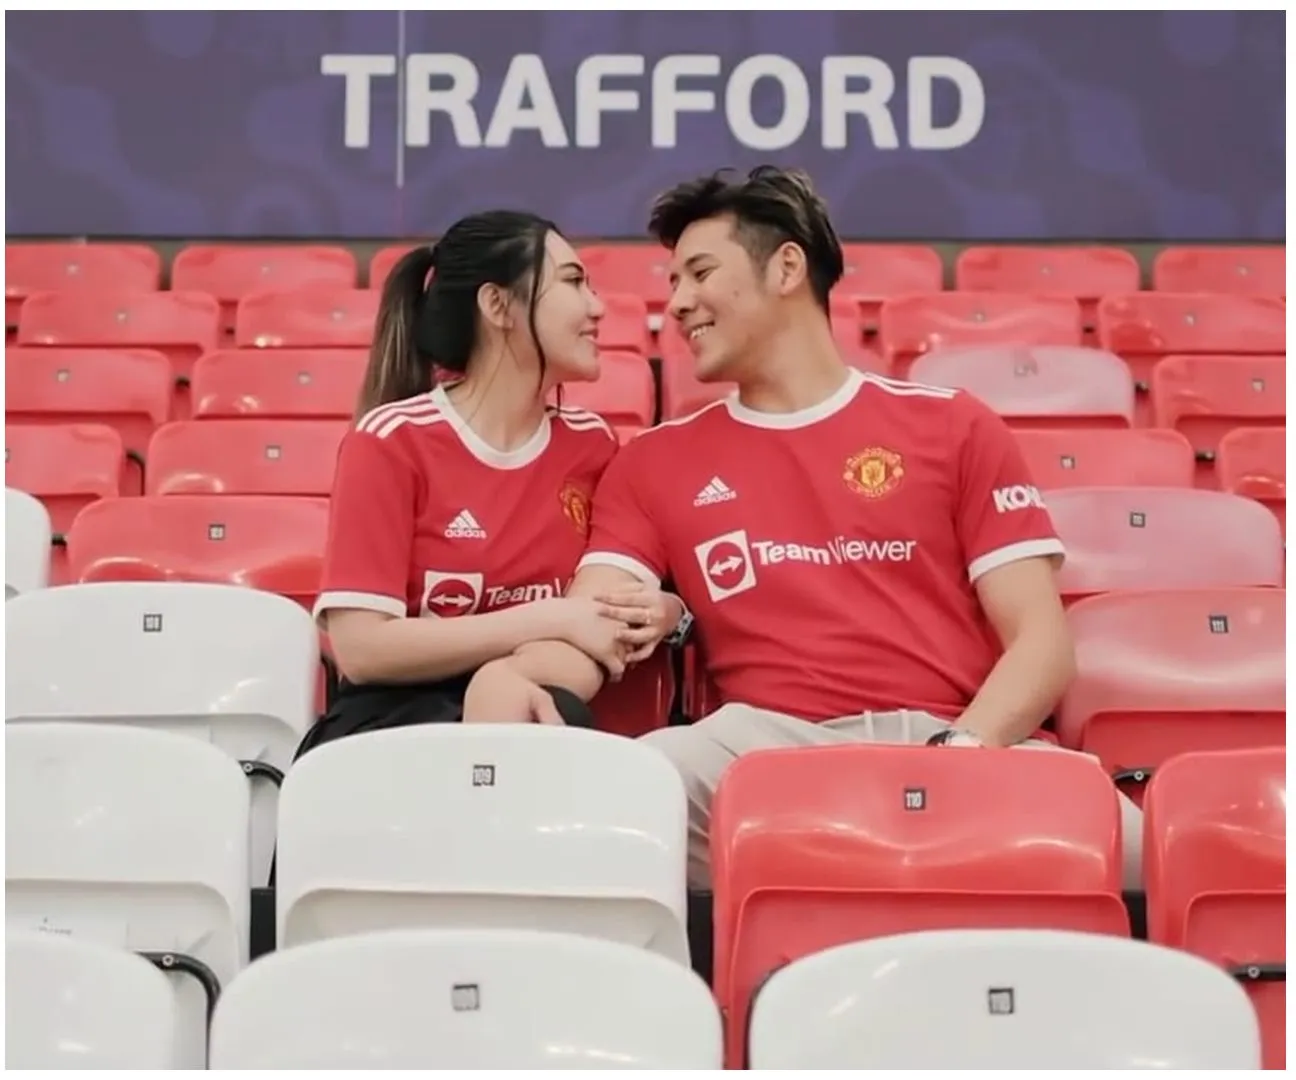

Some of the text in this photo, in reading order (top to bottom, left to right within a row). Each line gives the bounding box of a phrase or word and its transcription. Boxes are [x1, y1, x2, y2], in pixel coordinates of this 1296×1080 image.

[320, 53, 985, 151] TRAFFORD
[444, 527, 488, 540] adidas
[751, 535, 917, 566] TeamViewer
